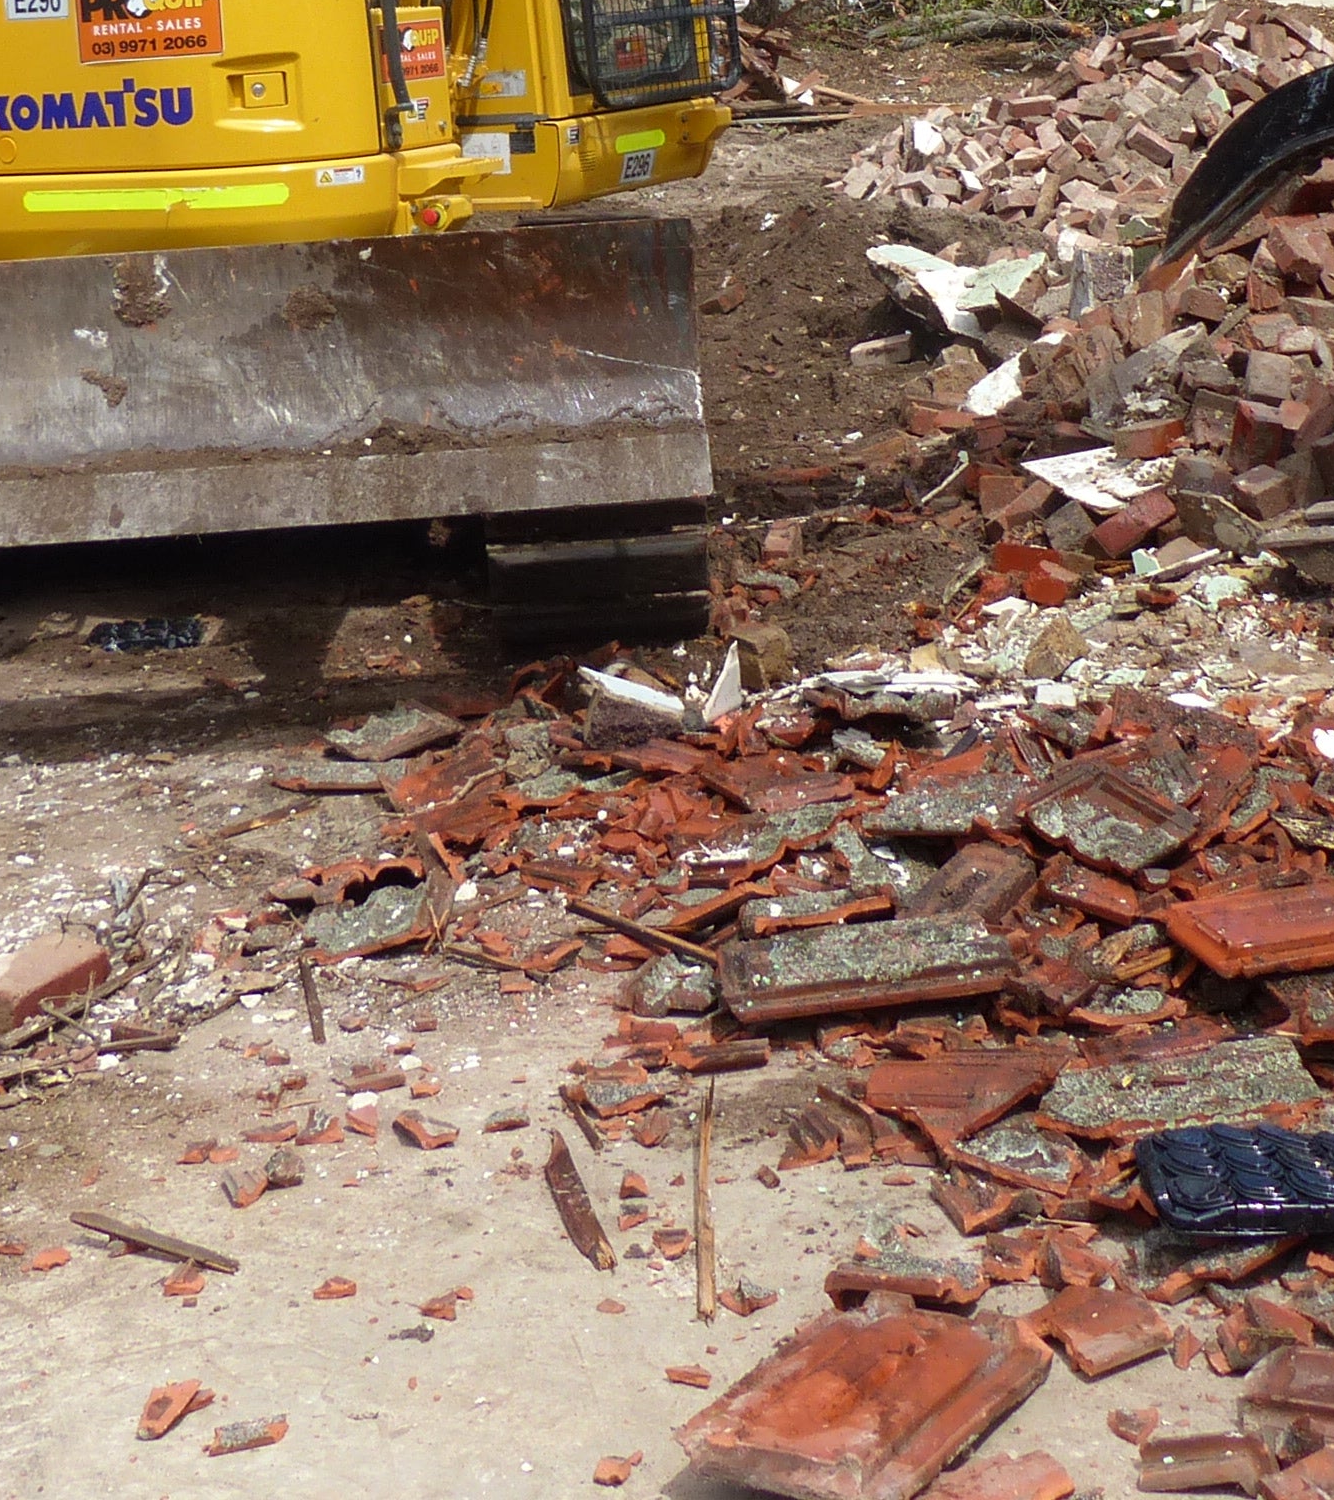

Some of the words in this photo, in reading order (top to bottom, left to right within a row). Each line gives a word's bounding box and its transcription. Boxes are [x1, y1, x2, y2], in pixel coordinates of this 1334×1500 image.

[93, 22, 143, 37] RENTAL
[156, 17, 202, 32] SALES
[92, 41, 115, 57] 03)
[119, 37, 157, 54] 9971
[163, 34, 207, 50] 2066
[624, 153, 651, 179] E296
